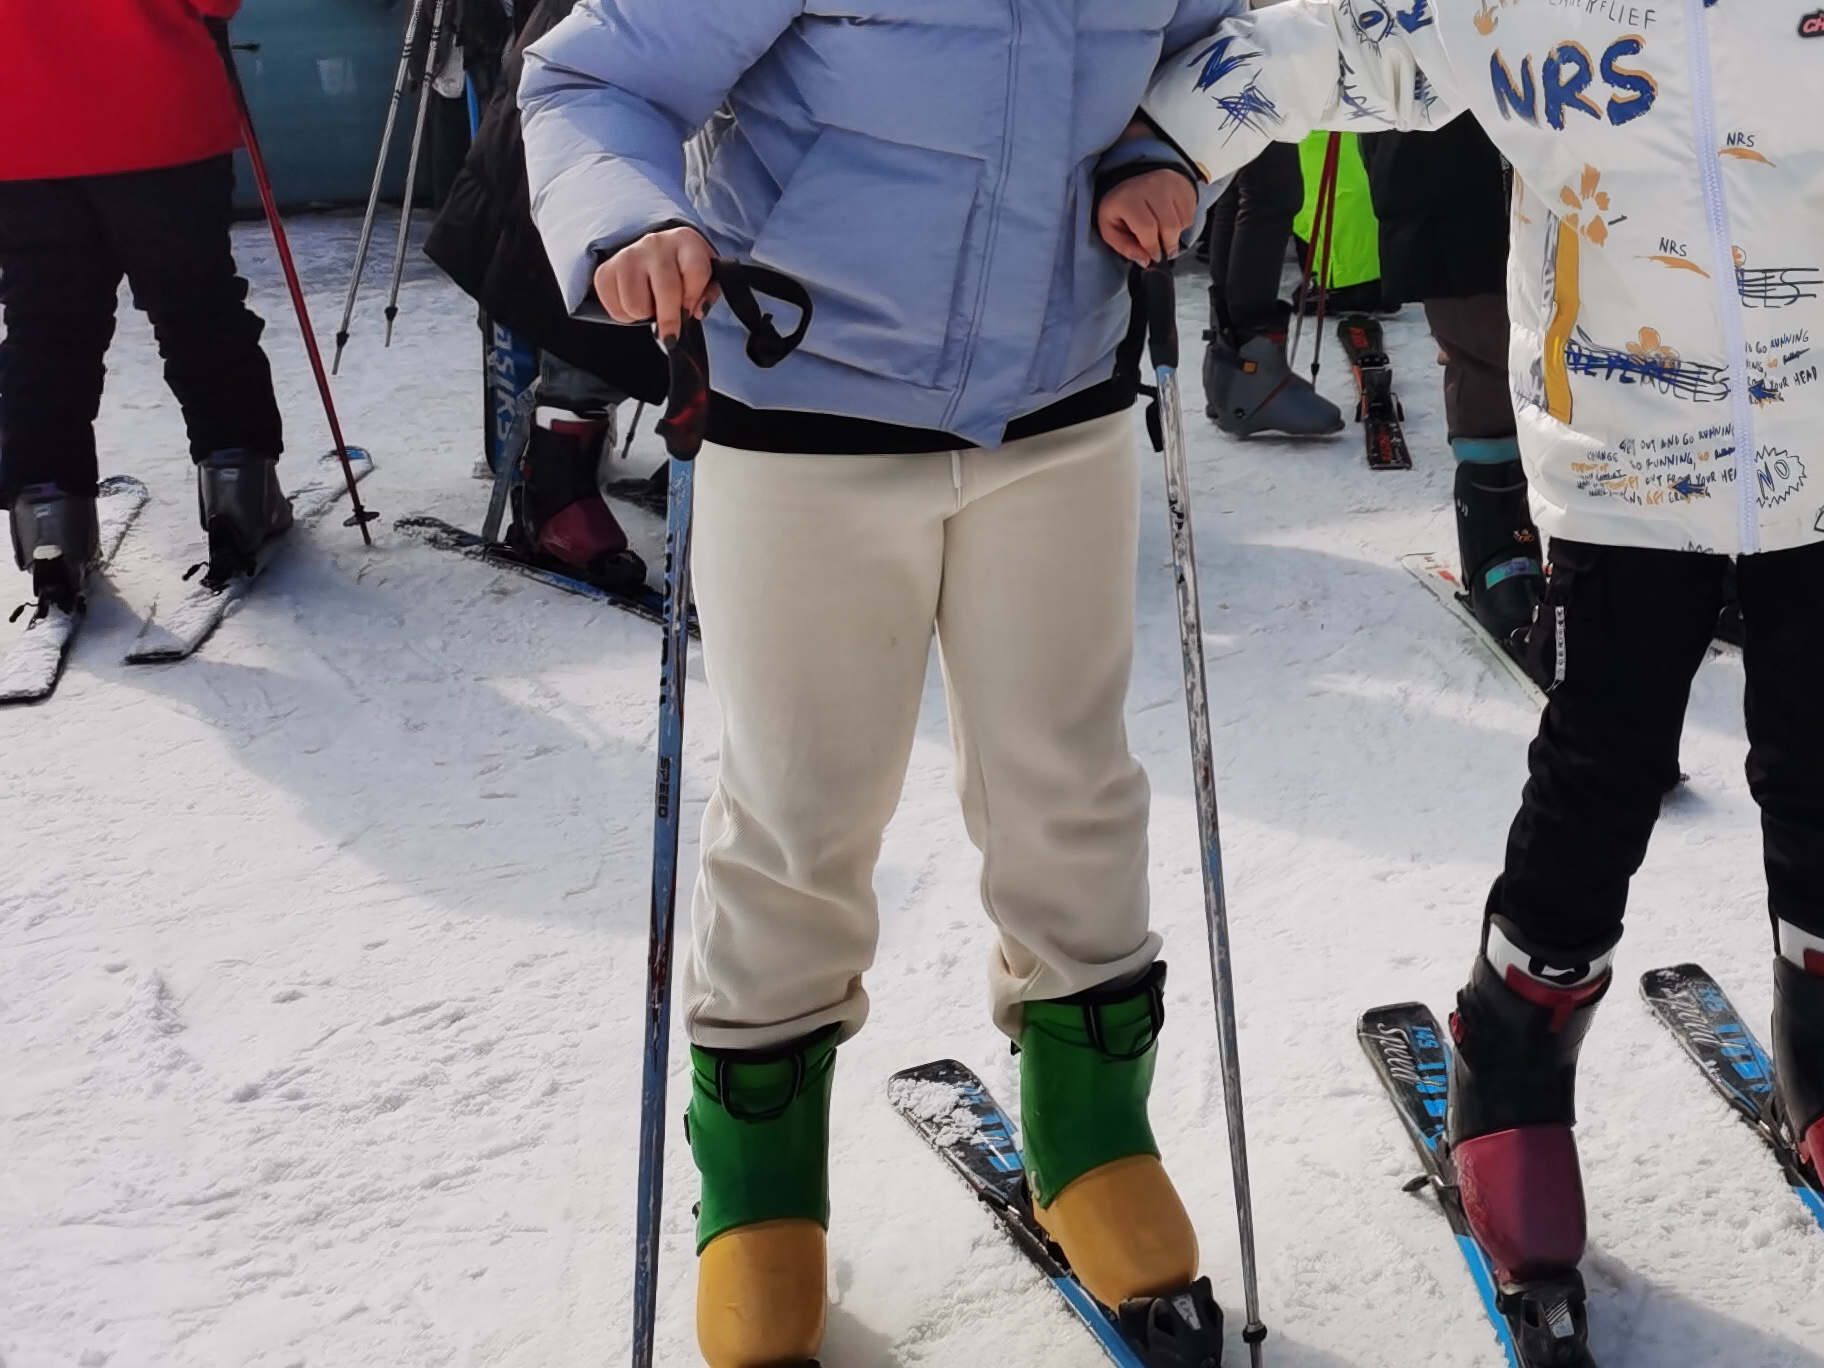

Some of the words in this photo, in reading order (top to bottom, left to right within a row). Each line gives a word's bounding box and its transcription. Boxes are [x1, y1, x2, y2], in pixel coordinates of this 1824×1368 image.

[1489, 34, 1658, 131] NRS
[1726, 132, 1755, 147] NRS
[1659, 237, 1687, 257] NRS
[1756, 341, 1767, 354] GO
[1771, 329, 1809, 348] RUNNING
[1793, 366, 1817, 386] HEAD
[1641, 439, 1655, 453] OUT
[1661, 434, 1680, 450] AND
[1682, 433, 1694, 446] GO
[1757, 459, 1789, 500] NO
